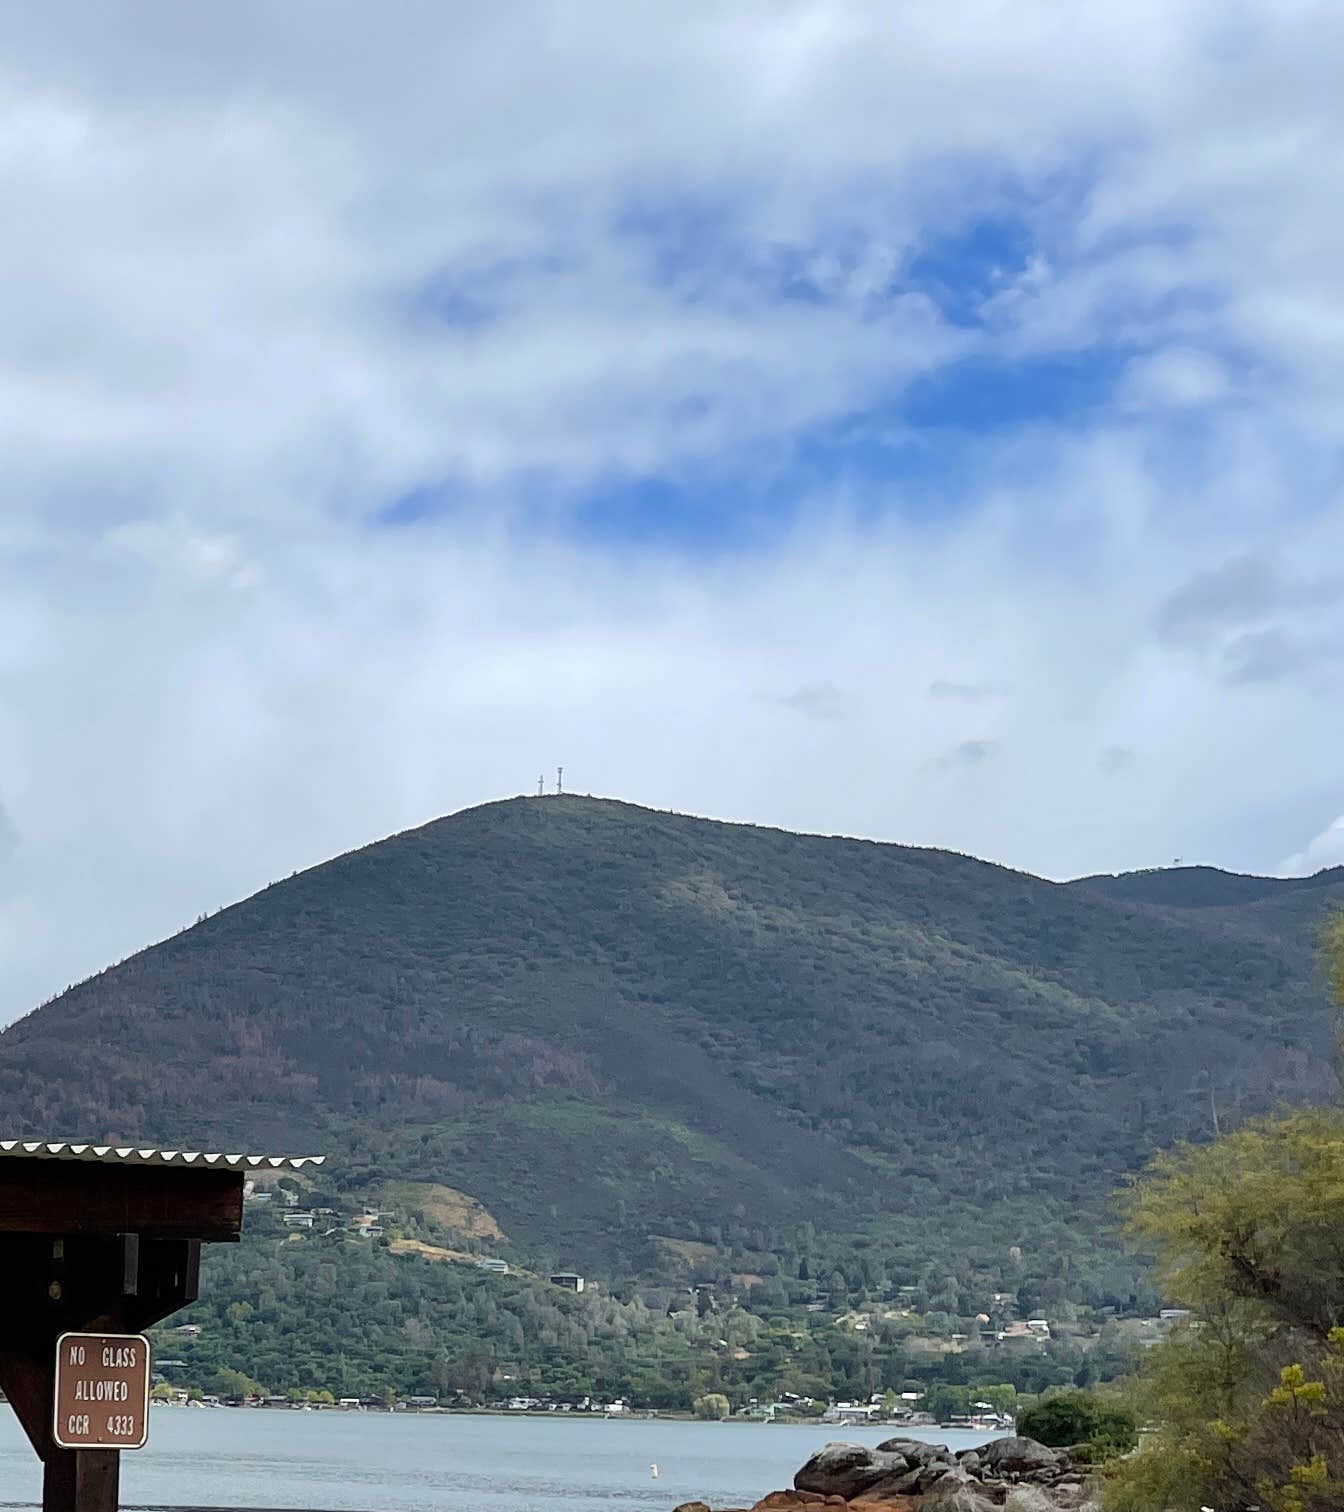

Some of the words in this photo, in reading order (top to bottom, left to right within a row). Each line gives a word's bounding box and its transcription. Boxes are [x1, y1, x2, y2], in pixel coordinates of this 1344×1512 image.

[69, 1346, 86, 1366] NO
[102, 1347, 136, 1368] GLASS
[75, 1380, 128, 1401] ALLOWED
[68, 1415, 90, 1434] CCR
[106, 1415, 134, 1436] 4333
